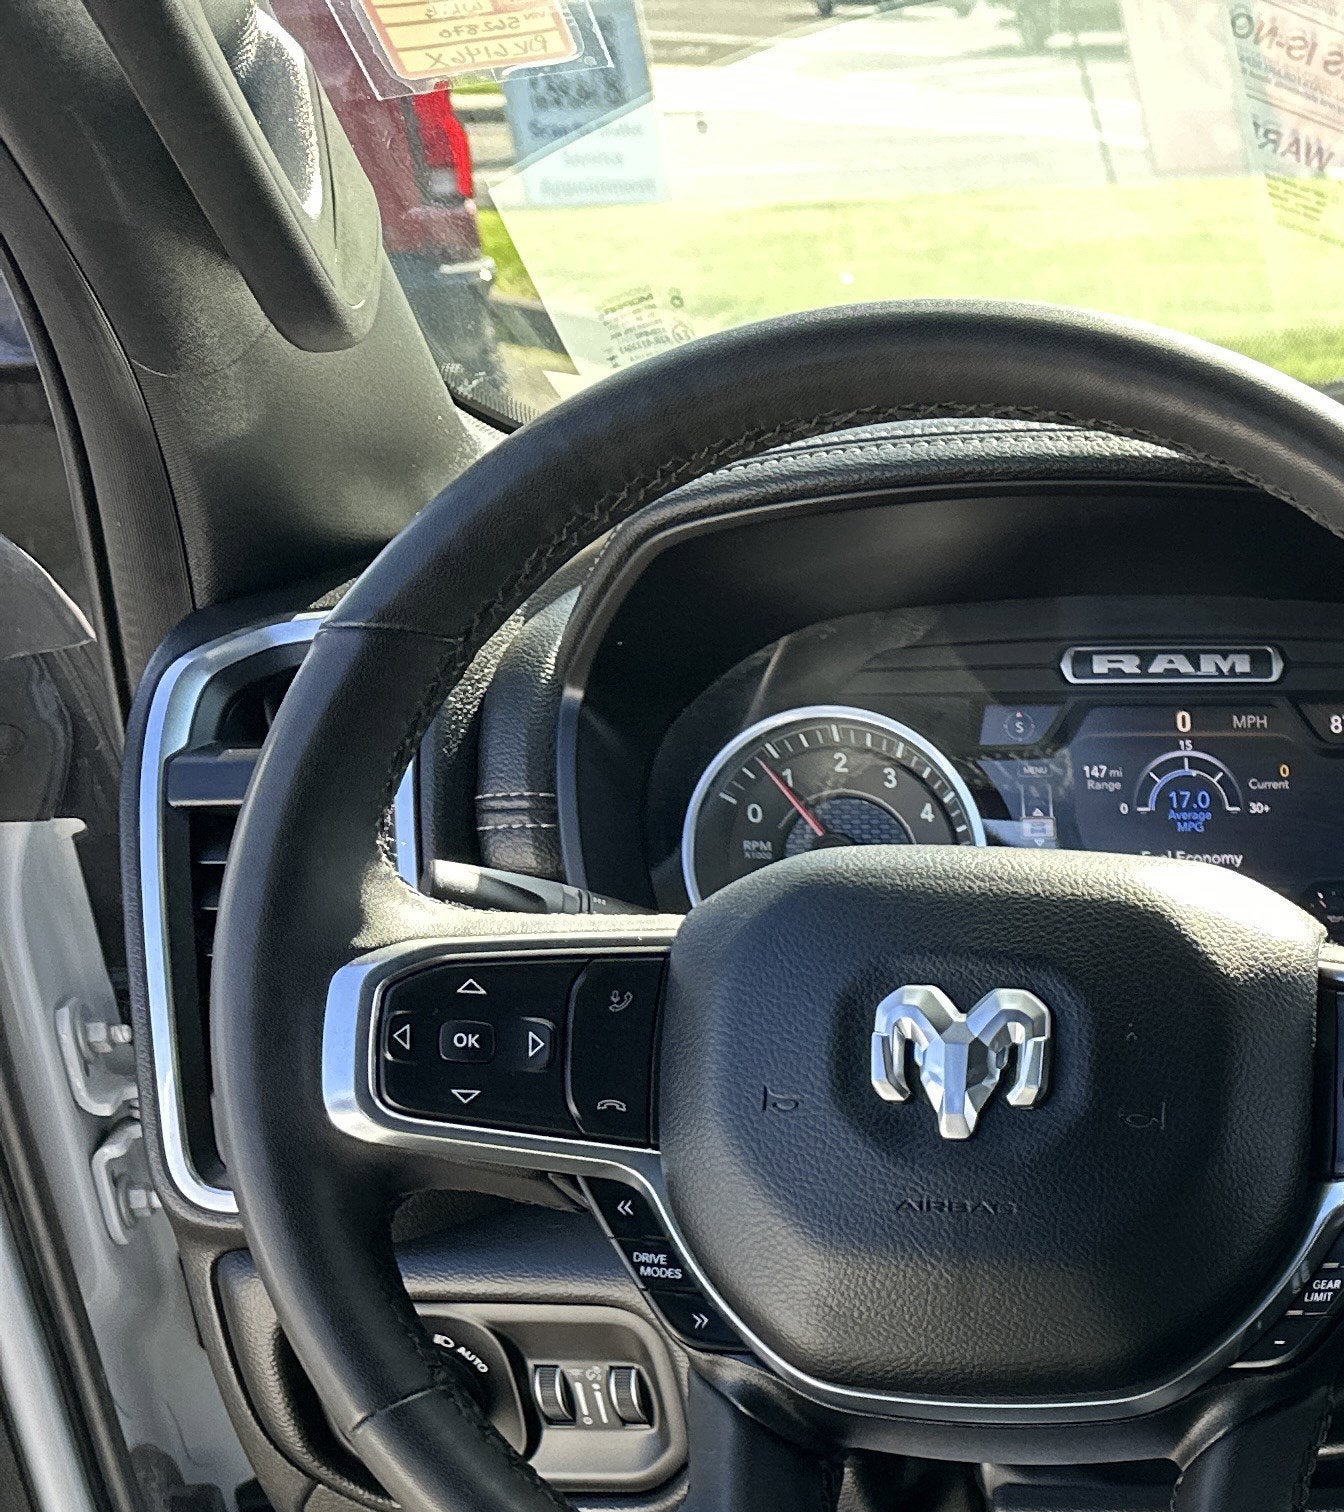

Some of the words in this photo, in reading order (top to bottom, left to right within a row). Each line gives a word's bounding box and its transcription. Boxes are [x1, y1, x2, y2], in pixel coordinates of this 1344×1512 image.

[1091, 653, 1252, 675] RAM
[1015, 720, 1025, 734] S
[1175, 709, 1192, 733] 0
[1232, 714, 1268, 730] MPH
[1178, 740, 1193, 751] 15
[833, 752, 849, 773] 2
[782, 768, 795, 788] 1
[882, 767, 898, 789] 3
[1083, 765, 1107, 778] 147
[1109, 767, 1123, 778] mi
[1279, 763, 1291, 778] 0
[1086, 779, 1122, 792] Range
[1248, 778, 1291, 791] Current
[1168, 790, 1211, 810] 17.0
[747, 803, 764, 823] 0
[920, 802, 936, 823] 4
[1120, 803, 1130, 816] 0
[1168, 809, 1213, 822] Average
[1249, 803, 1272, 815] 30+
[1176, 820, 1205, 834] MPG
[742, 839, 772, 851] RPM
[1175, 850, 1244, 867] Economy
[453, 1032, 480, 1049] OK
[632, 1251, 668, 1266] DRIVE
[639, 1266, 683, 1280] MODES
[1312, 1279, 1342, 1290] GEAR
[1304, 1291, 1334, 1302] LIMIT
[456, 1345, 490, 1374] AUTO
